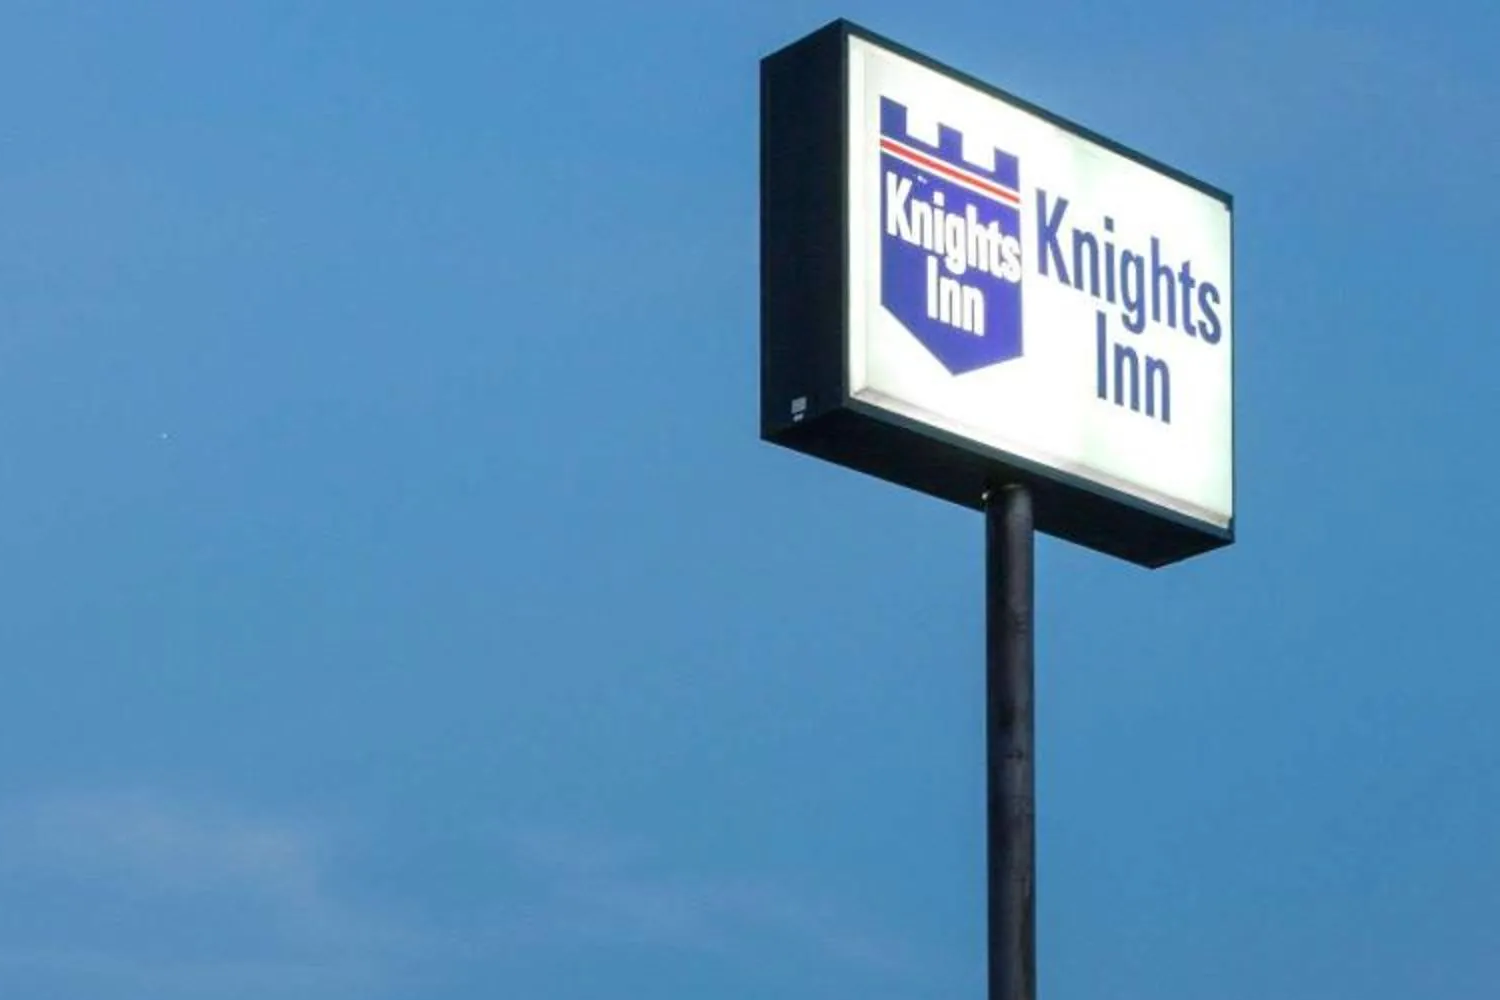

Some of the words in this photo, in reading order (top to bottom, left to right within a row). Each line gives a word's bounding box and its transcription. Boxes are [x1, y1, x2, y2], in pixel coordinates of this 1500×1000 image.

[886, 173, 1021, 283] Knights
[1036, 188, 1222, 345] Knights
[926, 255, 985, 337] Inn
[1097, 311, 1171, 425] Inn
